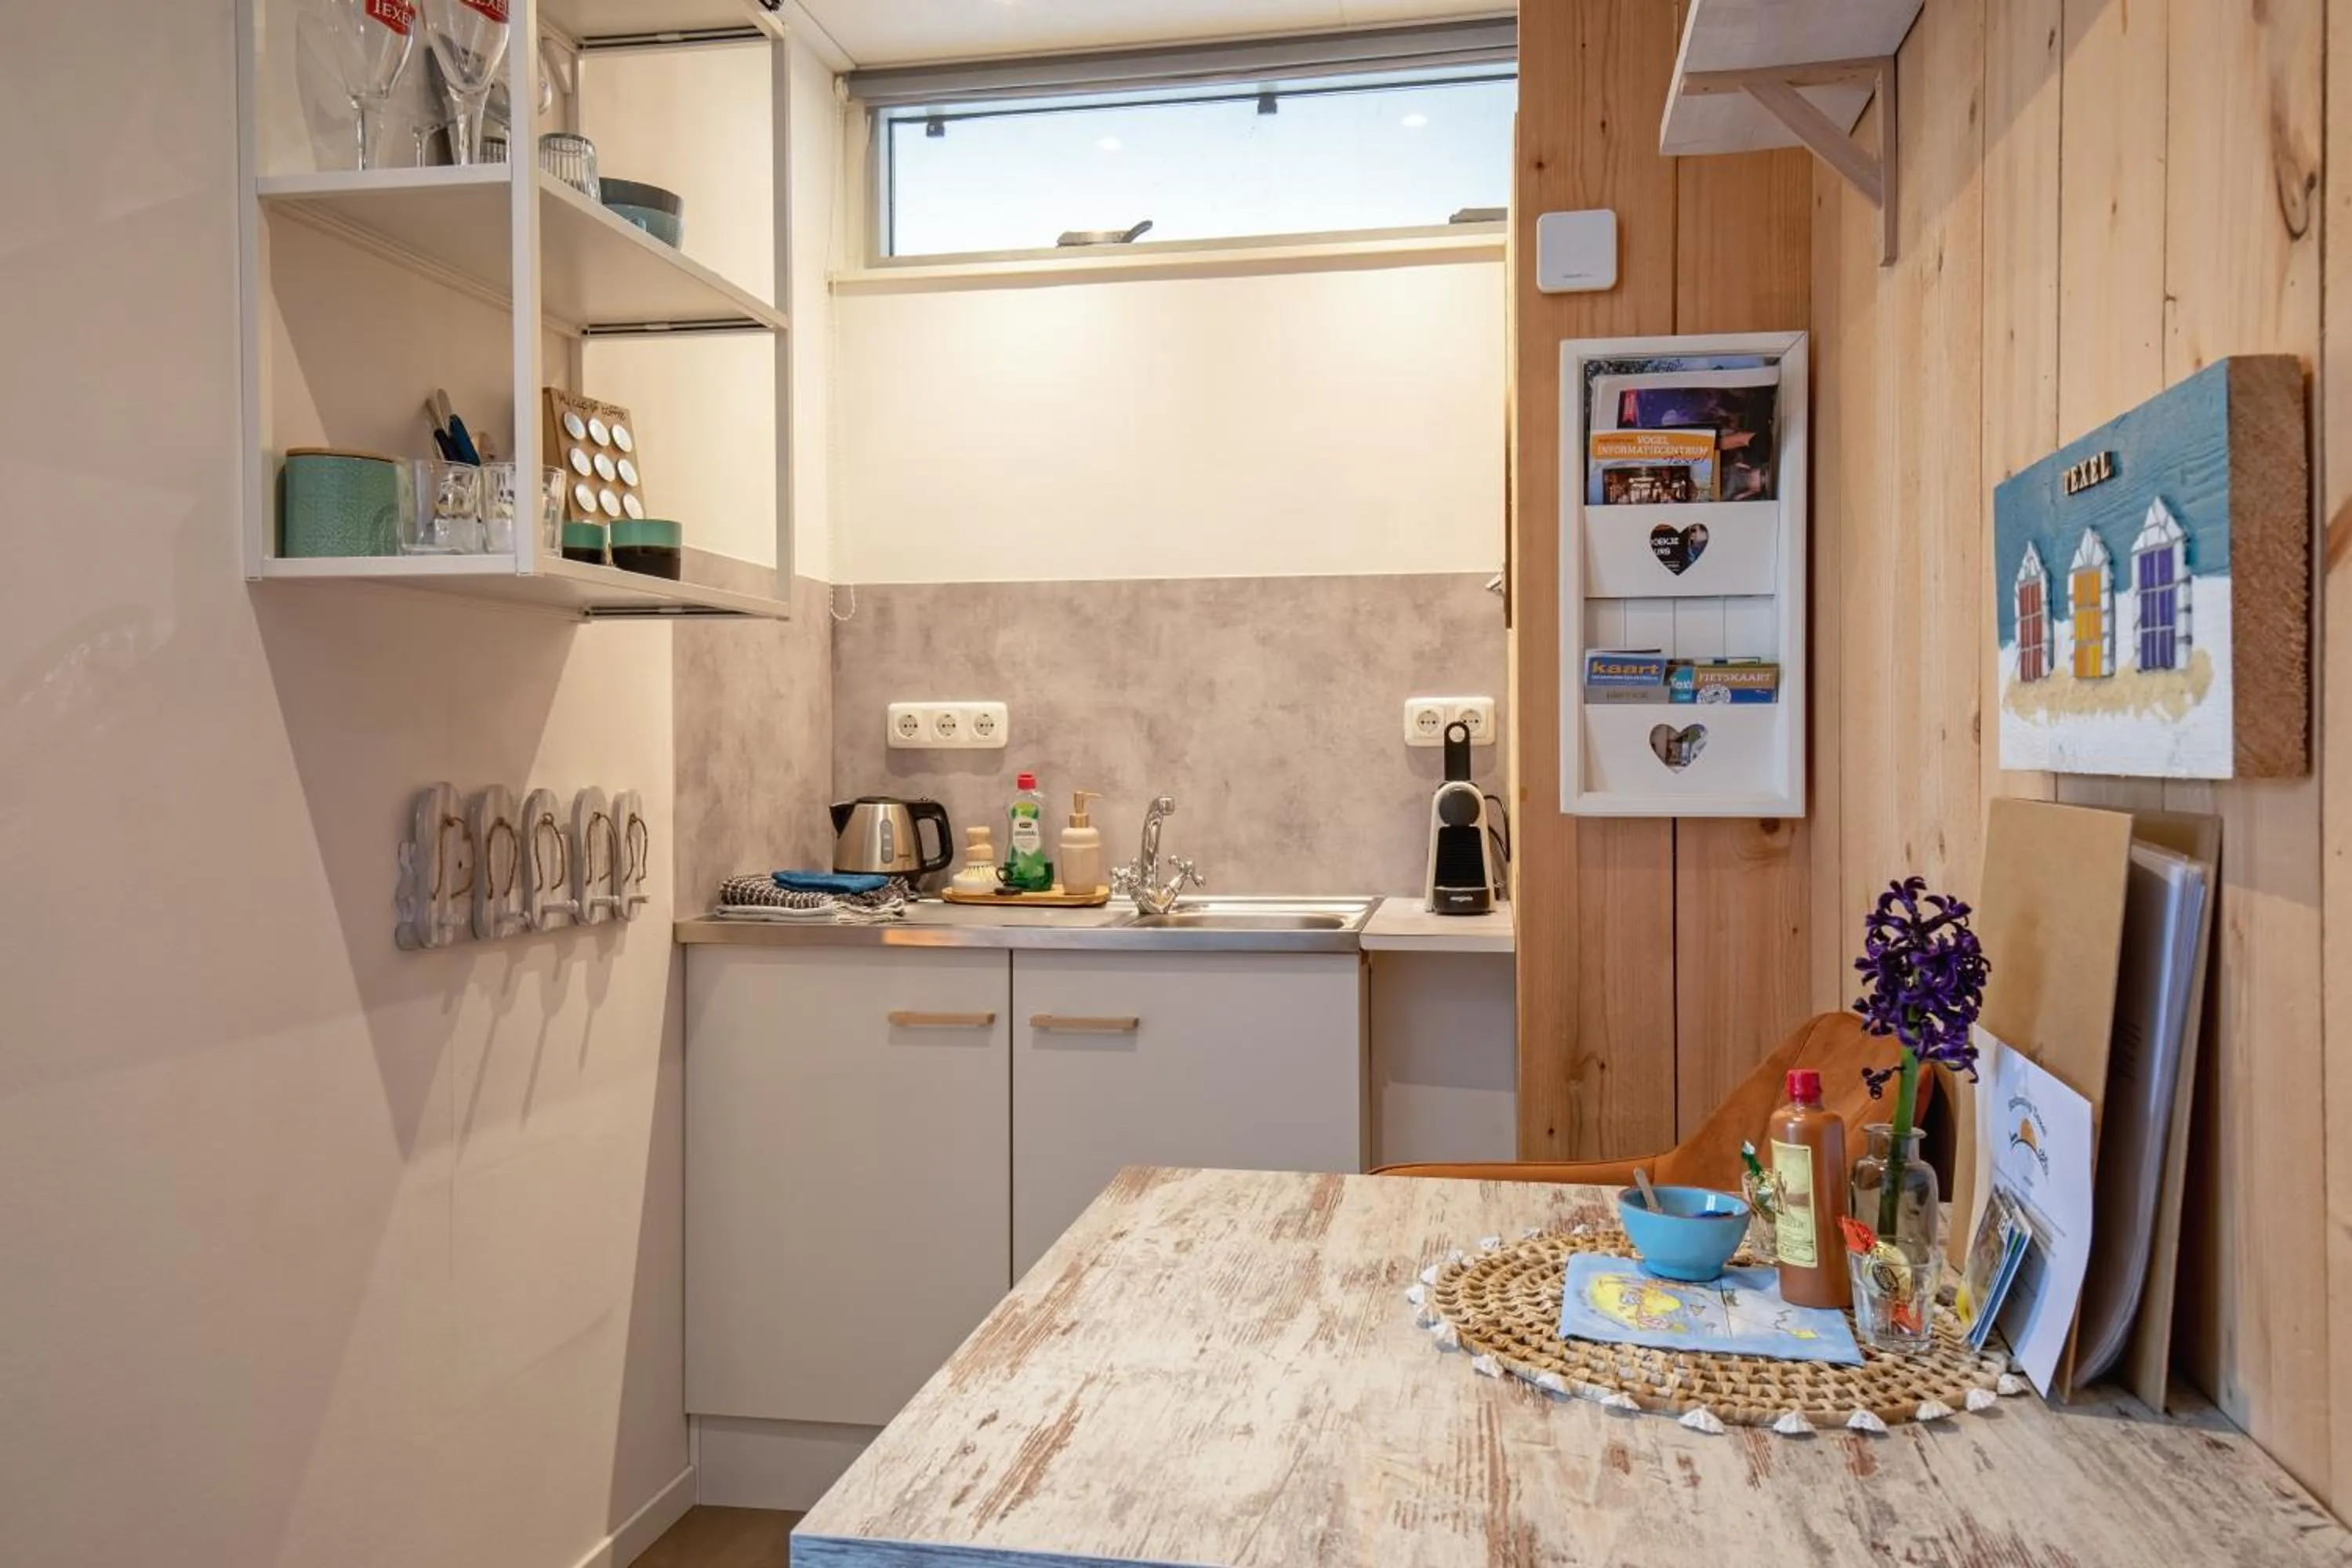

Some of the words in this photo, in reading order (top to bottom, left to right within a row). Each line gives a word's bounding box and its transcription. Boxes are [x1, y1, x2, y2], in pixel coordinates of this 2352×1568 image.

[2062, 451, 2111, 495] TEXEL
[1592, 660, 1660, 675] kaart
[1699, 671, 1771, 682] FIETSKAART
